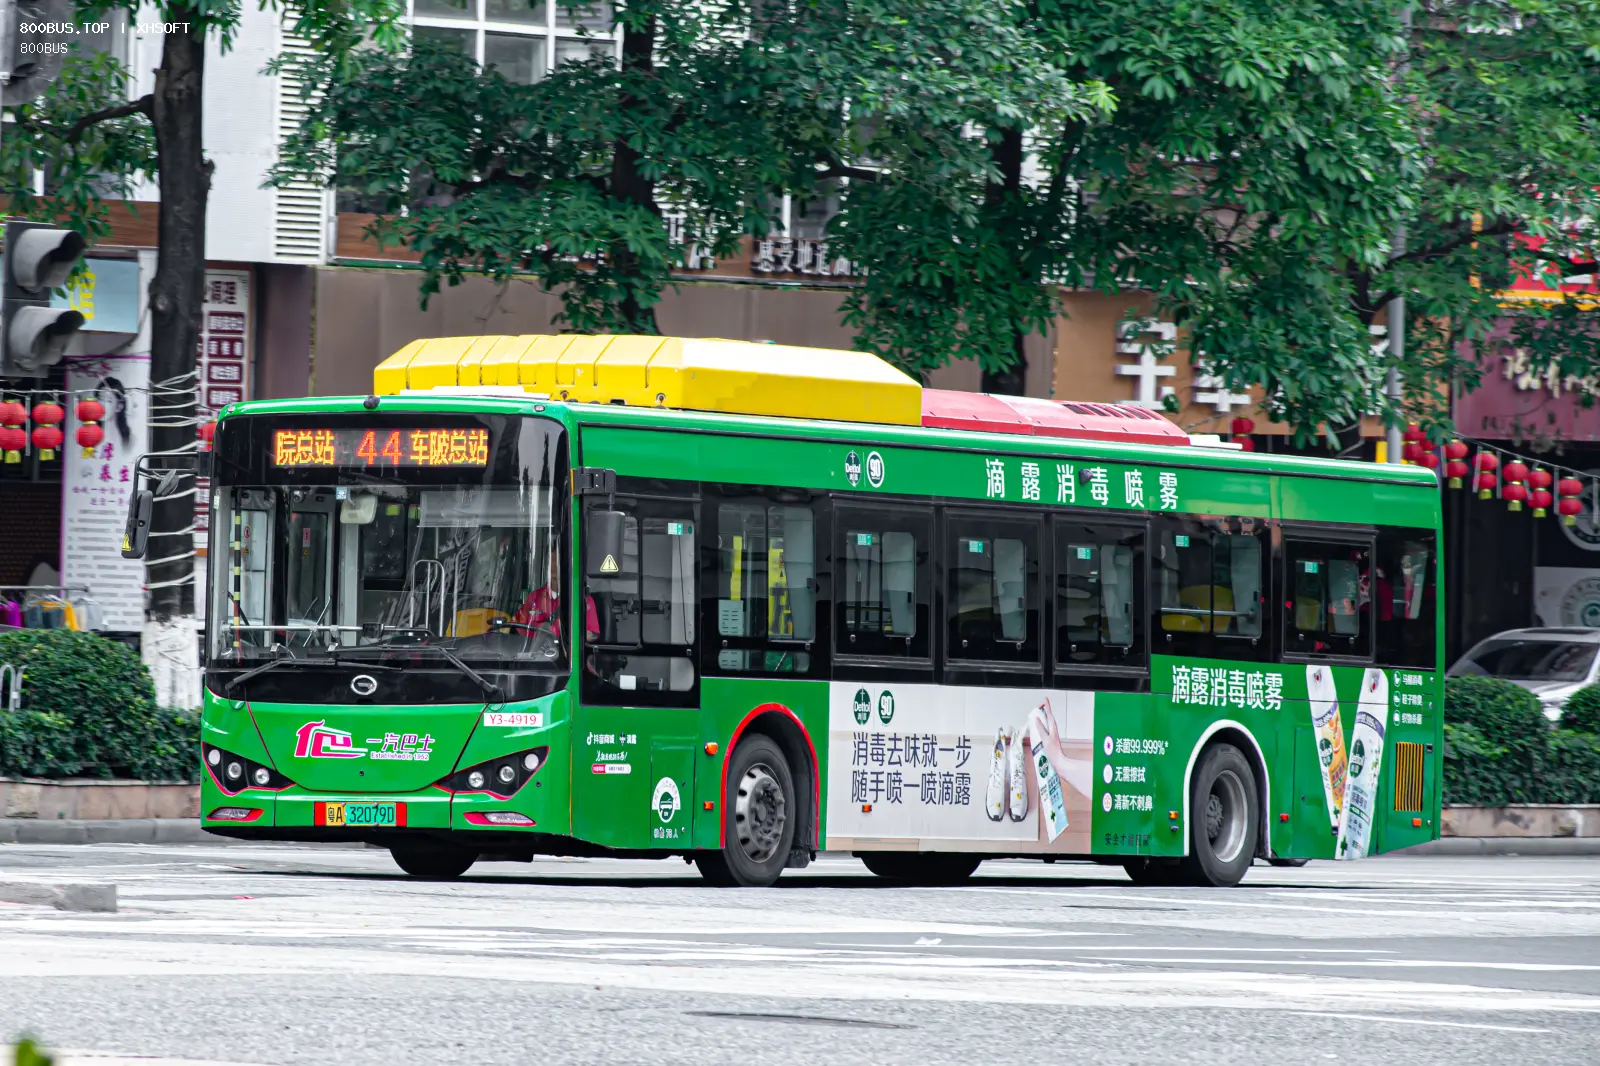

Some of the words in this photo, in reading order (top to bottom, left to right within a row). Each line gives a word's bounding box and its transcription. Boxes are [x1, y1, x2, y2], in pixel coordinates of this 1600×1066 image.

[275, 430, 335, 466] 院总站
[356, 431, 402, 465] 44
[410, 430, 488, 466] 车陂总站
[985, 458, 1179, 510] 滴露消毒喷雾
[1171, 664, 1284, 710] 滴露消毒喷雾
[854, 701, 876, 713] Dettol
[489, 714, 537, 725] Y3-4919
[366, 732, 435, 752] 一汽巴士
[852, 731, 972, 769] 消毒去味就一步
[1115, 766, 1146, 783] 无需擦拭
[851, 769, 971, 806] 随手喷一喷滴露
[1114, 794, 1153, 812] 清新不刺鼻
[349, 806, 395, 823] 32079D
